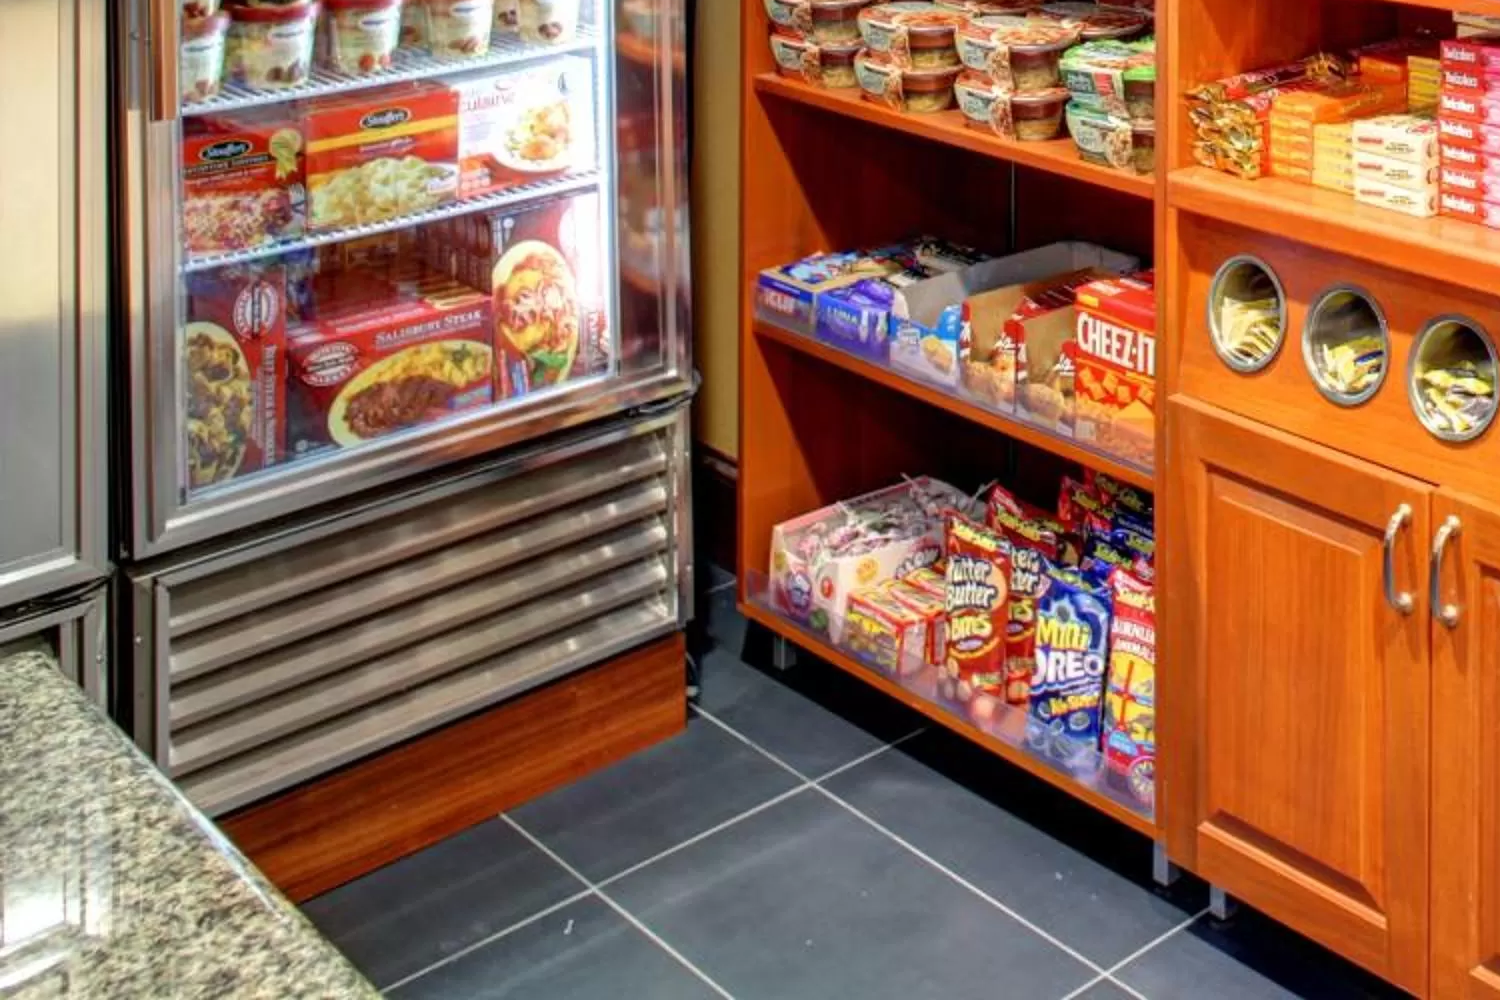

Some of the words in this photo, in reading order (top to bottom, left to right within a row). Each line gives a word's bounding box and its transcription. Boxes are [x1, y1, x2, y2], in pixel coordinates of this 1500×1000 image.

[375, 321, 442, 344] SALISBURY
[444, 310, 482, 327] STEAK
[1076, 310, 1156, 377] CHEEZ-IT
[1036, 614, 1090, 652] Mini
[1031, 650, 1105, 687] OREO
